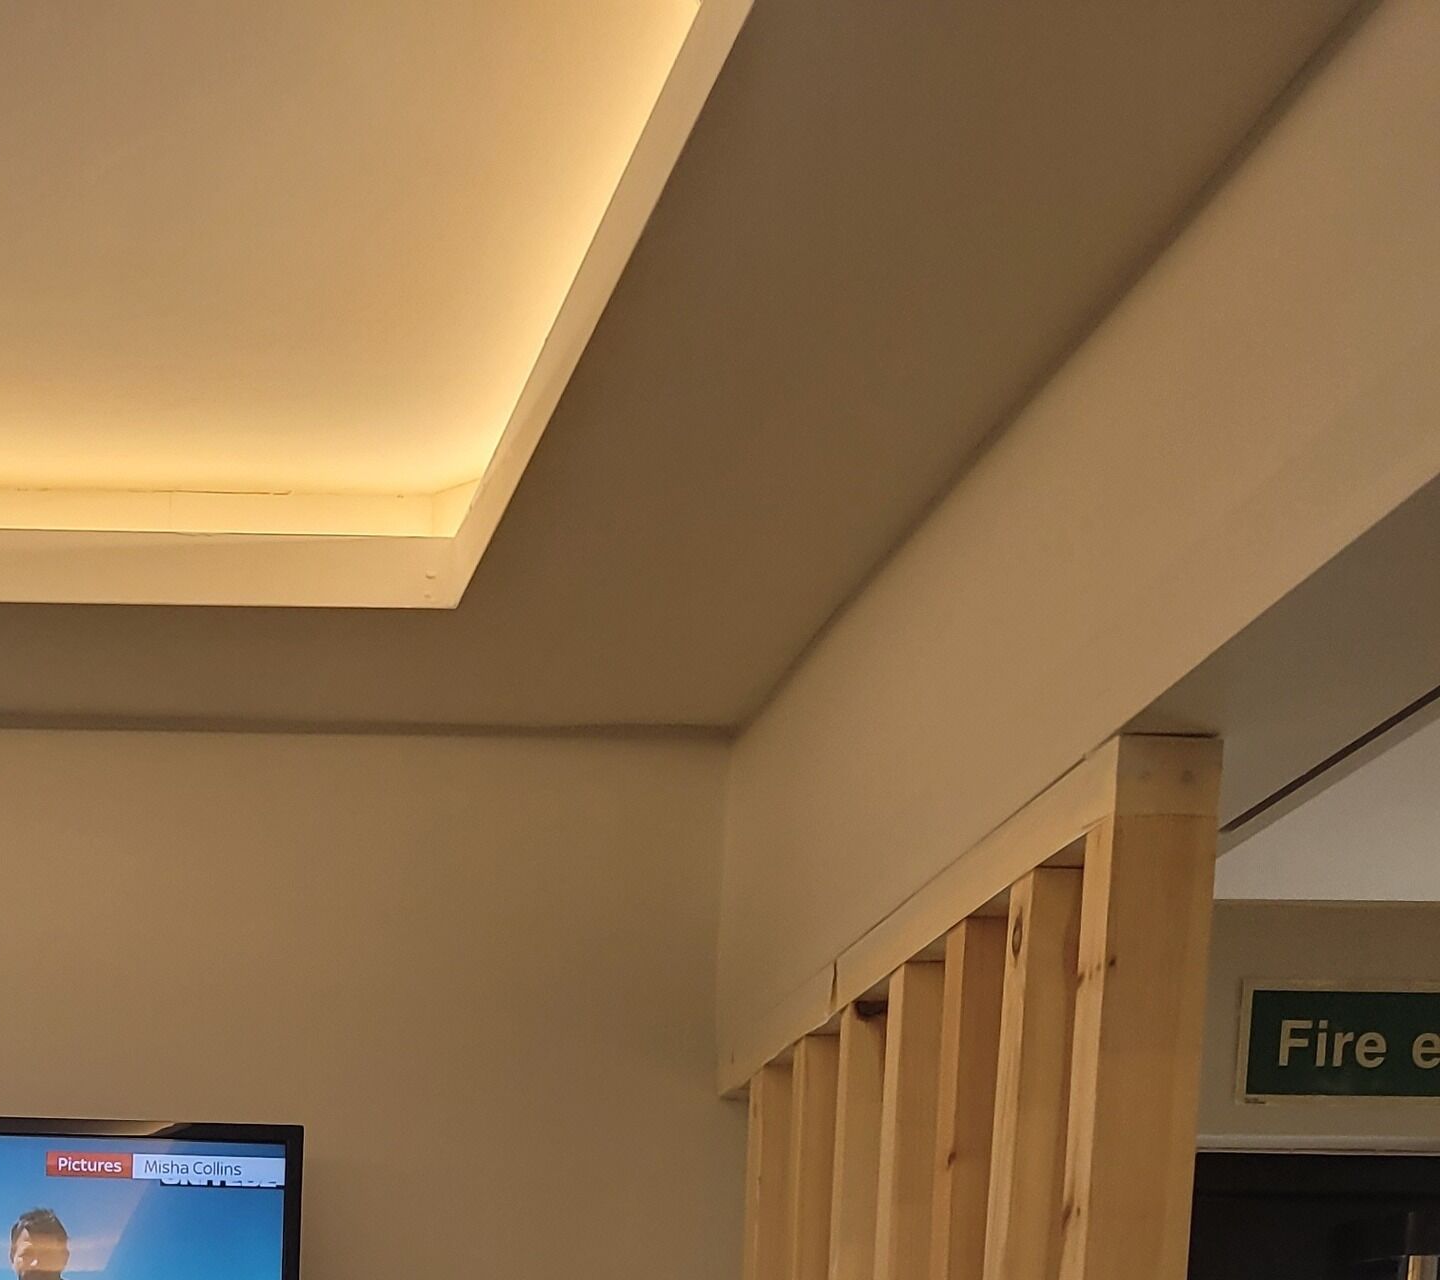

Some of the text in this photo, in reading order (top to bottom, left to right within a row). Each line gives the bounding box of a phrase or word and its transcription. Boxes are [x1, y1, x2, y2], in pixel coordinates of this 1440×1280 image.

[1278, 1019, 1388, 1069] Fire
[57, 1156, 123, 1174] Pictures
[144, 1159, 243, 1177] Misha Collins
